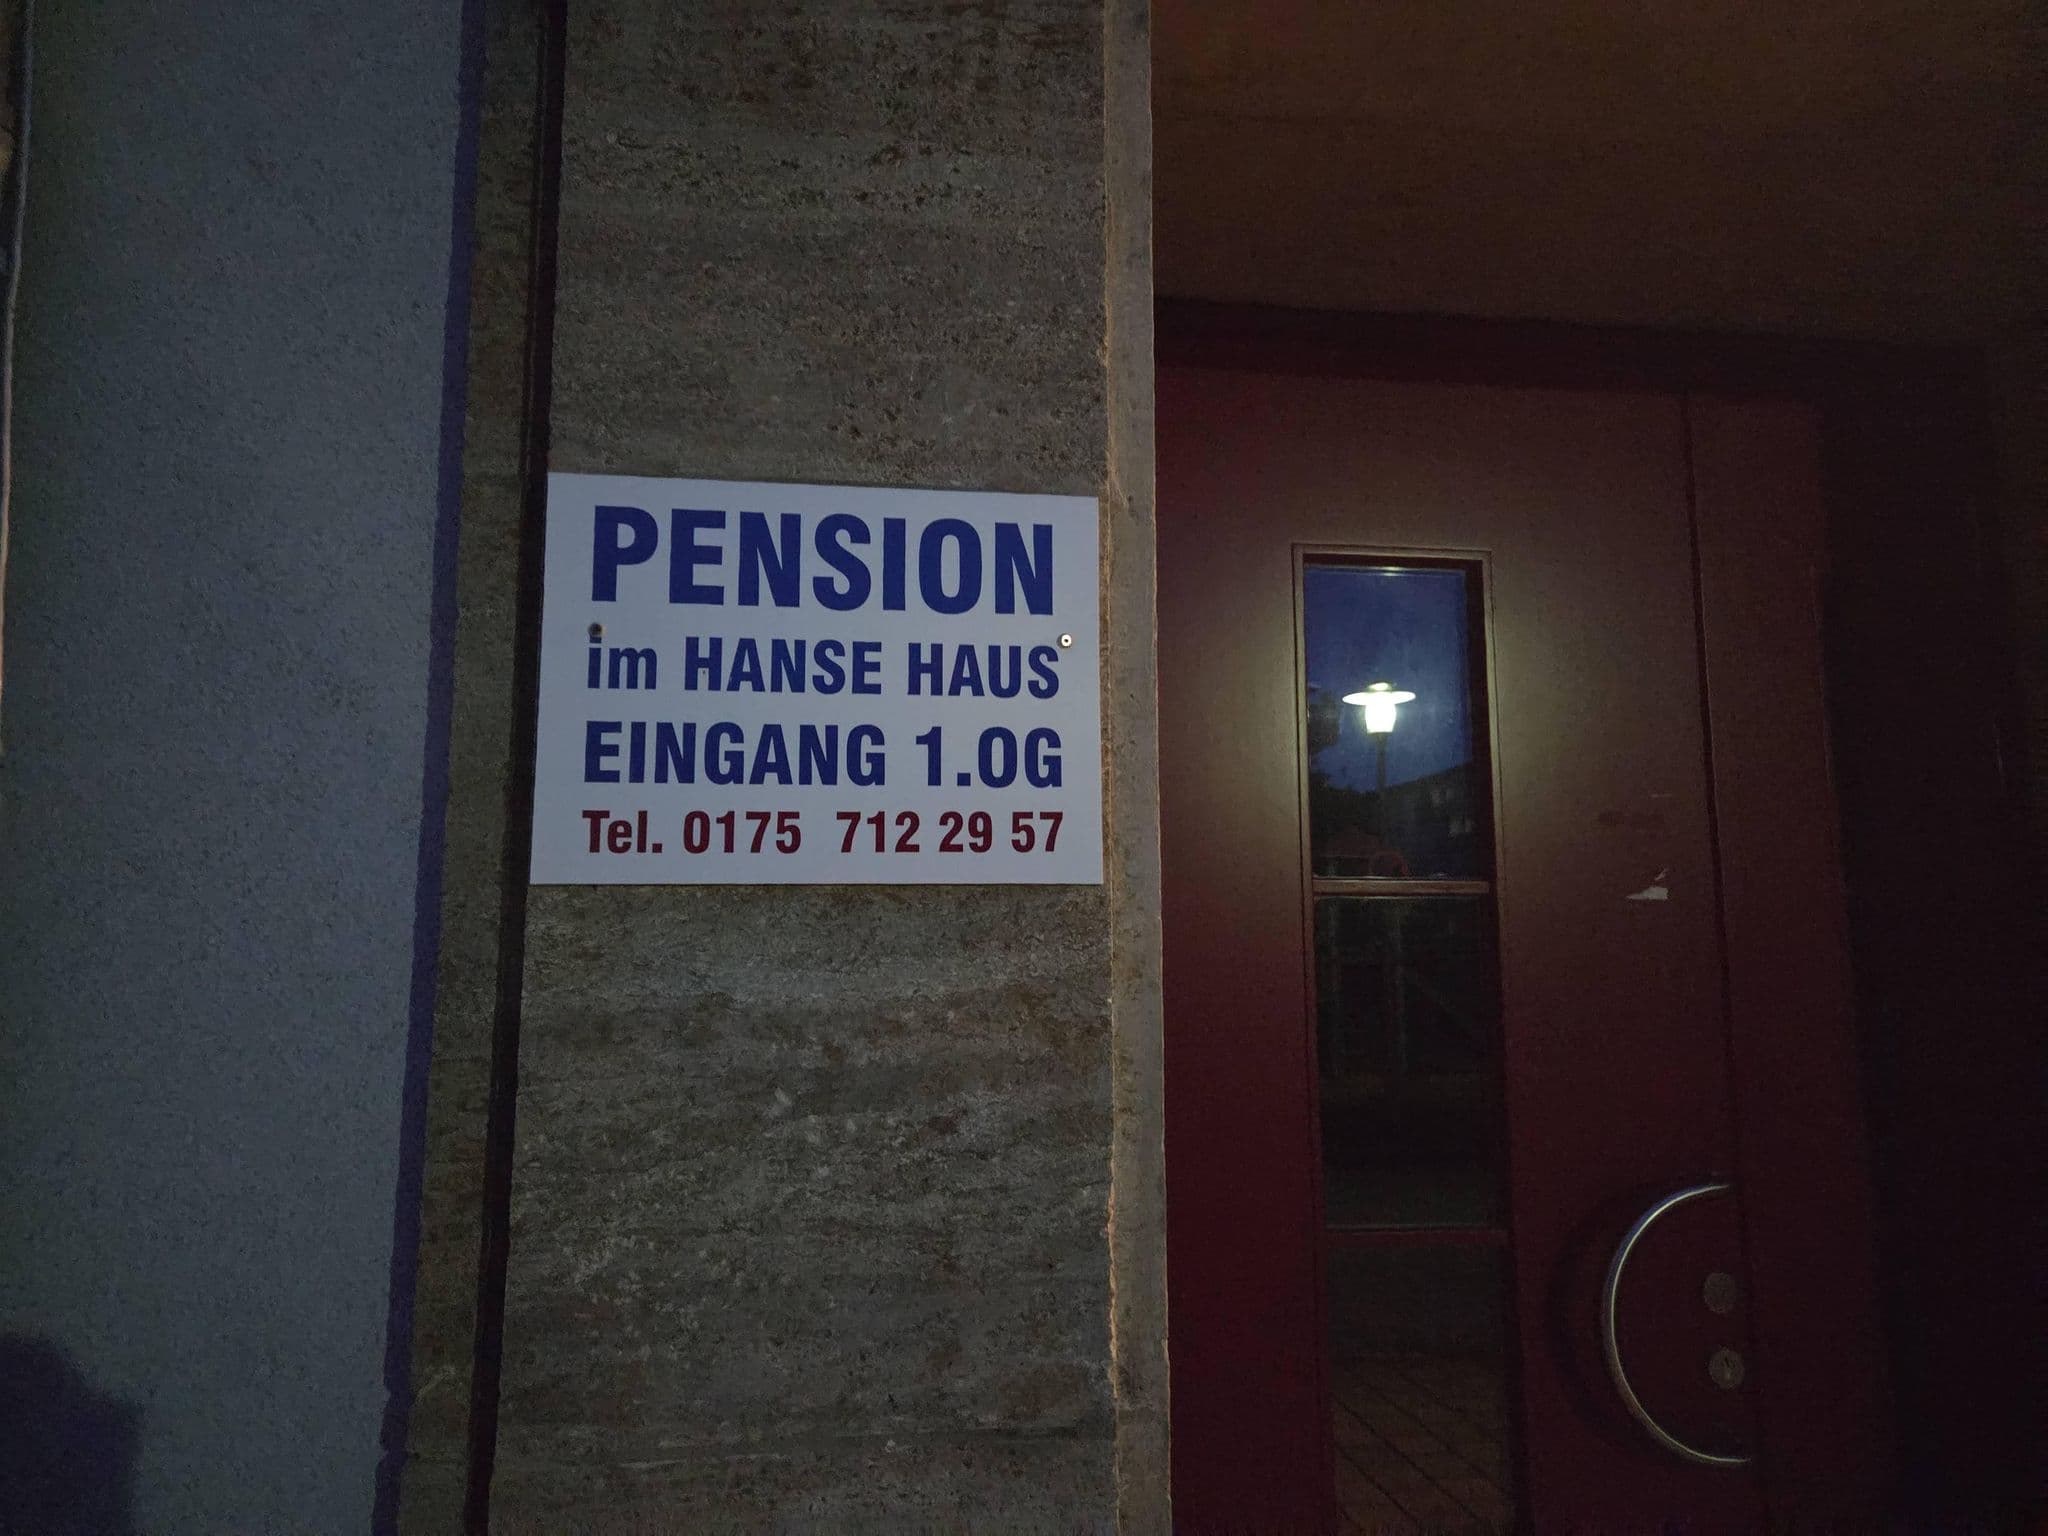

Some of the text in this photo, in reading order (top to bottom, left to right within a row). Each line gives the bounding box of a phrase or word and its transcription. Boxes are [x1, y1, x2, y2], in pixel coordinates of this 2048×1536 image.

[591, 505, 1054, 616] PENSION
[587, 635, 1060, 699] im HANSE HAUS
[584, 721, 1063, 788] EINGANG 1.OG
[582, 810, 1064, 854] Tel. 0175 712 29 57
